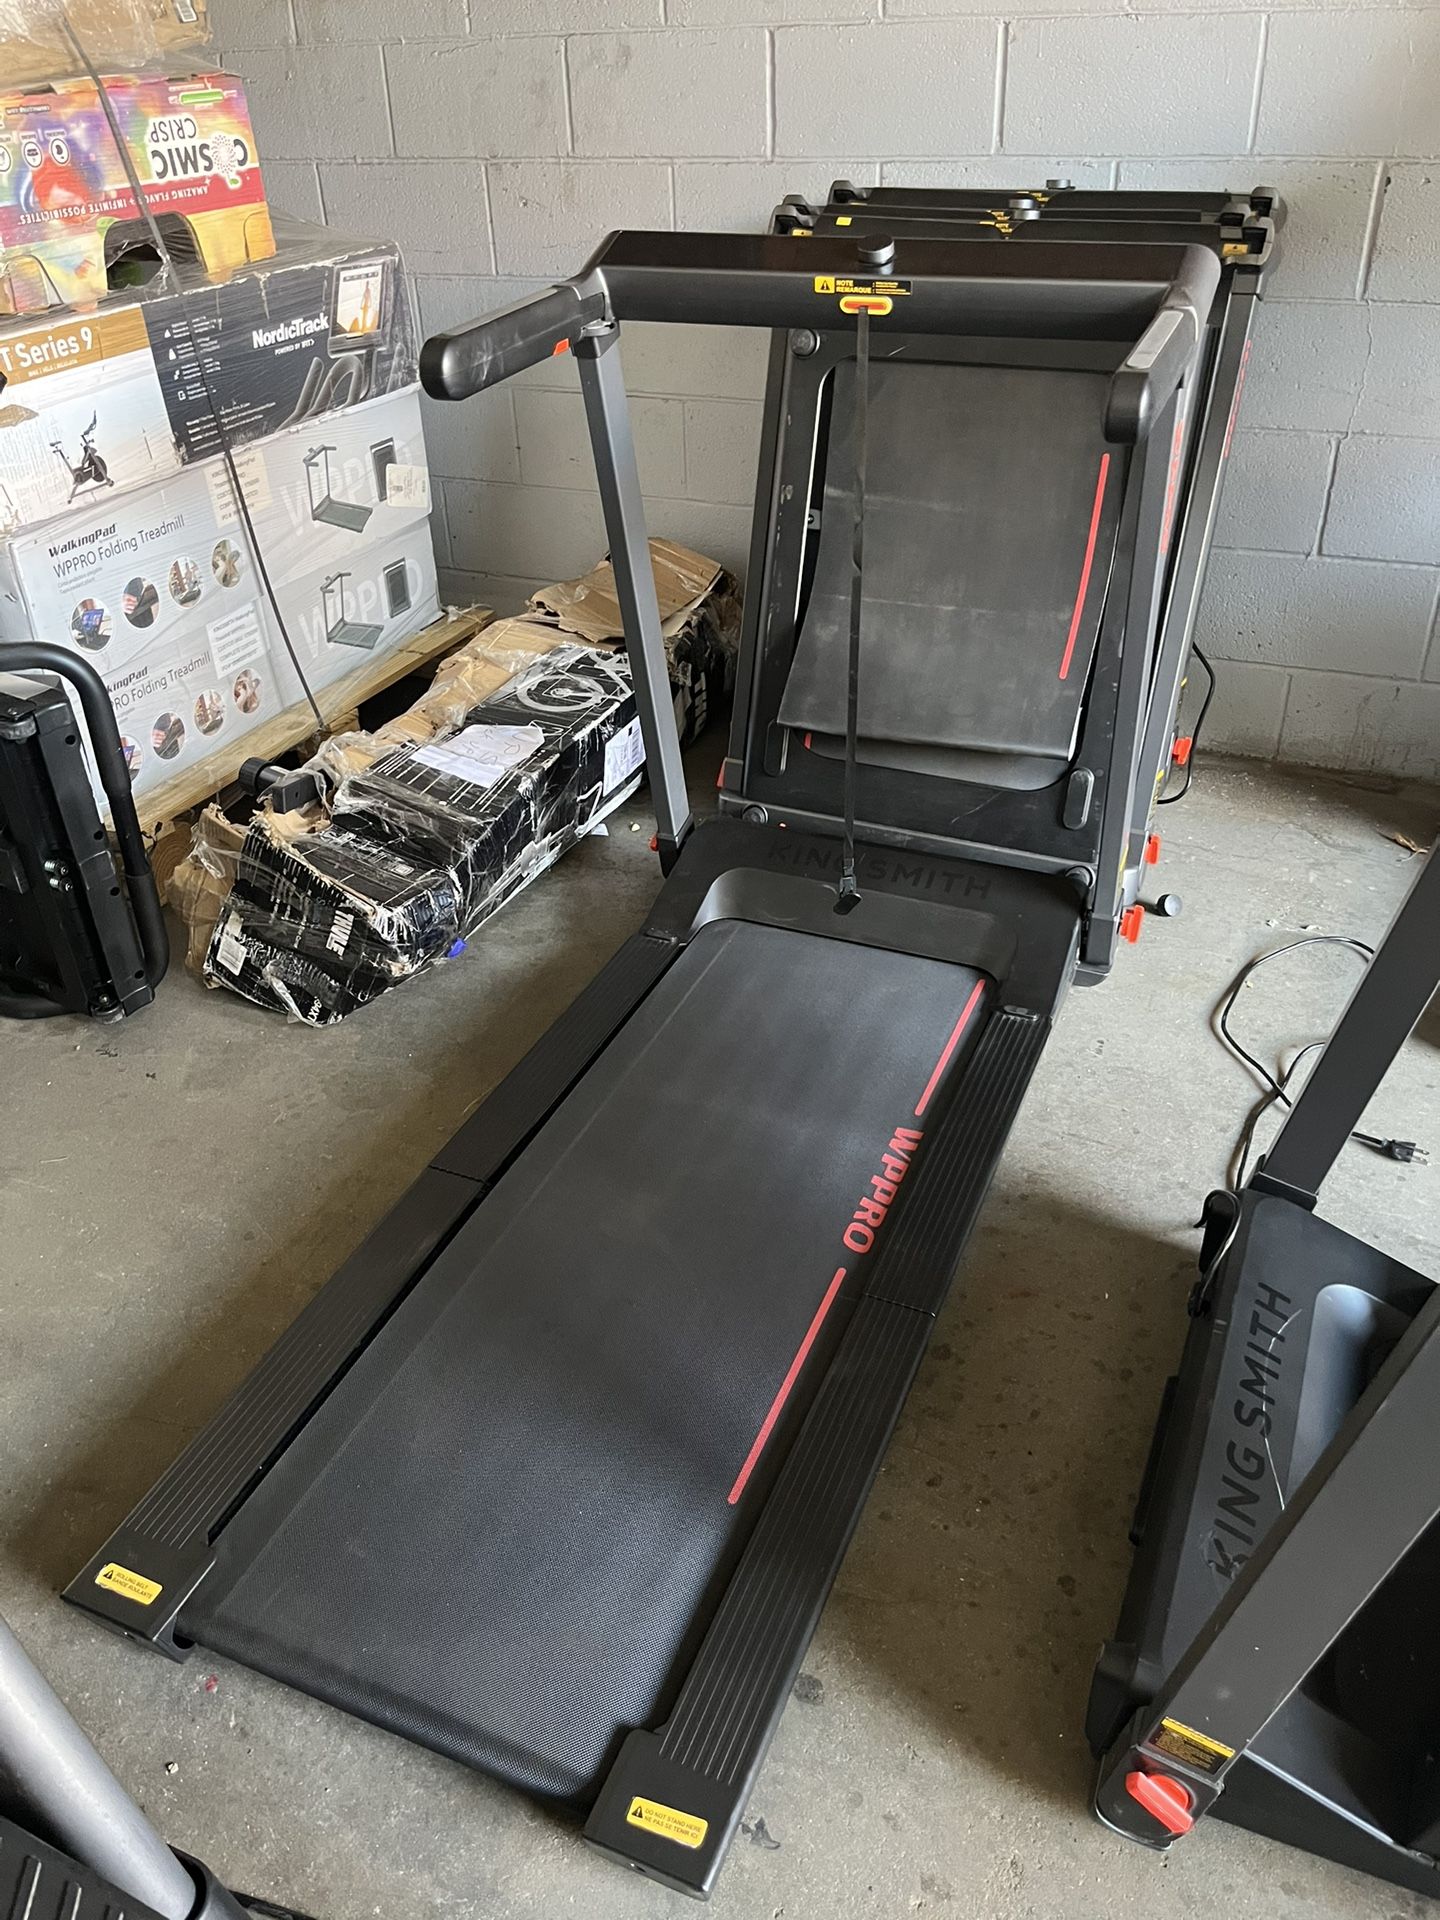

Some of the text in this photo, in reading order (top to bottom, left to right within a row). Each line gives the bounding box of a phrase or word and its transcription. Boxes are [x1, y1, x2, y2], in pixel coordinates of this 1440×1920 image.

[150, 117, 198, 142] CRISP
[91, 199, 128, 214] INFINITE
[170, 186, 208, 201] AMAZING
[14, 335, 80, 368] Series
[80, 326, 93, 351] 9
[252, 313, 330, 349] NordicTrack
[48, 523, 118, 558] WalkingPad
[53, 514, 186, 578] WPPRO Folding Treadmill
[131, 677, 168, 702] Folding
[167, 651, 211, 681] Treadmill
[325, 909, 355, 956] THULE
[842, 1126, 925, 1254] WPPRO
[645, 1807, 654, 1816] DO
[654, 1810, 666, 1820] NOT
[667, 1814, 686, 1828] STAND
[652, 1818, 665, 1828] PAS
[664, 1822, 673, 1831] SE
